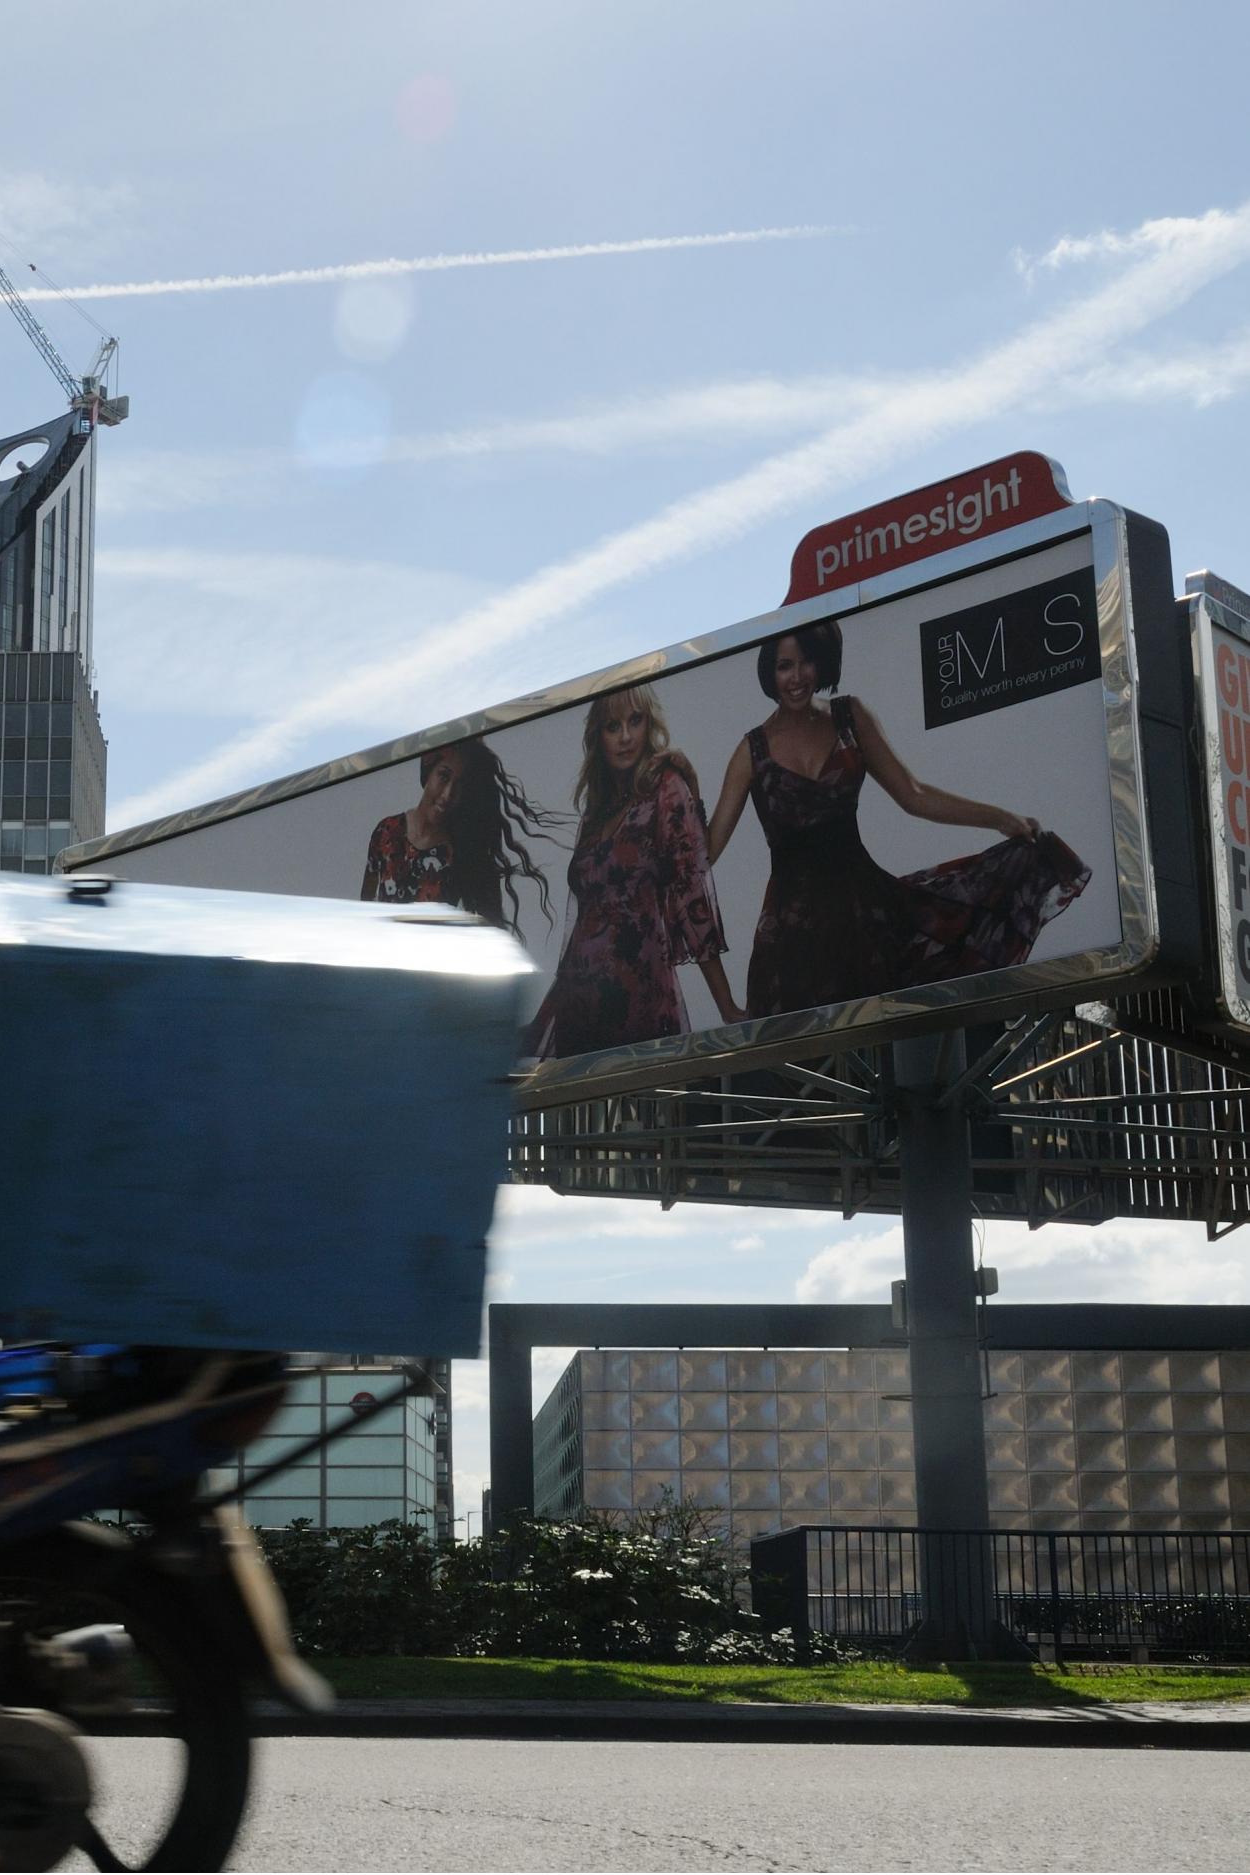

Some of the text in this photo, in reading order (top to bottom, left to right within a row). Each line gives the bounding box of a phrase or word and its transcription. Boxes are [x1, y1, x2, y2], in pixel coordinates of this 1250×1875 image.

[816, 467, 1022, 585] primesight
[938, 634, 955, 692] YOUR
[941, 656, 1086, 709] Quality worth every penny
[1217, 643, 1250, 717] GI
[1228, 780, 1250, 848] C
[1232, 847, 1250, 912] F
